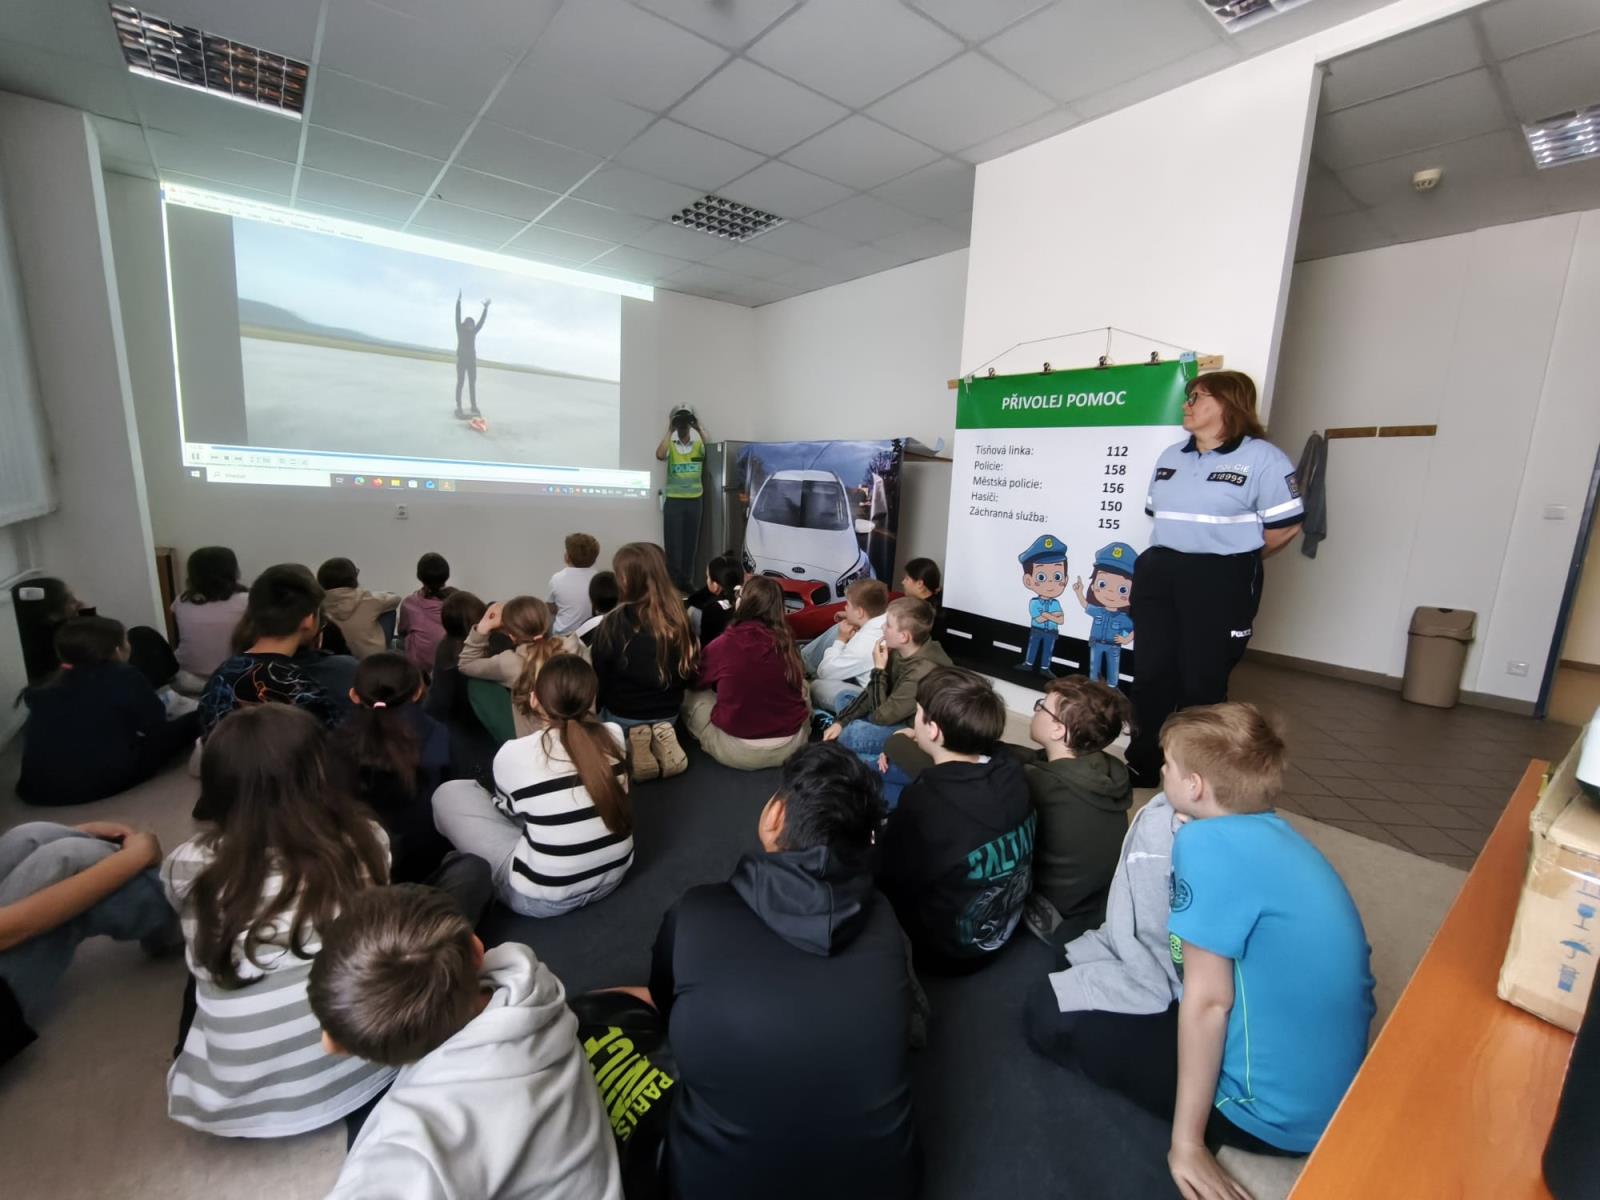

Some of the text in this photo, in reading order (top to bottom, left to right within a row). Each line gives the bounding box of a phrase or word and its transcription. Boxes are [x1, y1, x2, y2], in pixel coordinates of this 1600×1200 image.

[1001, 390, 1127, 410] PŘIVOLEJ POMOC
[975, 444, 1035, 456] Tisňová linka:
[1106, 446, 1129, 457] 112
[974, 460, 1004, 471] Policie:
[1104, 464, 1127, 475] 158
[972, 476, 1043, 490] Městská policie:
[1102, 482, 1125, 494] 156
[971, 491, 999, 503] Hasiči:
[1100, 500, 1123, 512] 150
[969, 505, 1049, 523] Záchranná služba:
[1098, 518, 1120, 530] 155
[615, 1071, 674, 1142] PARIS
